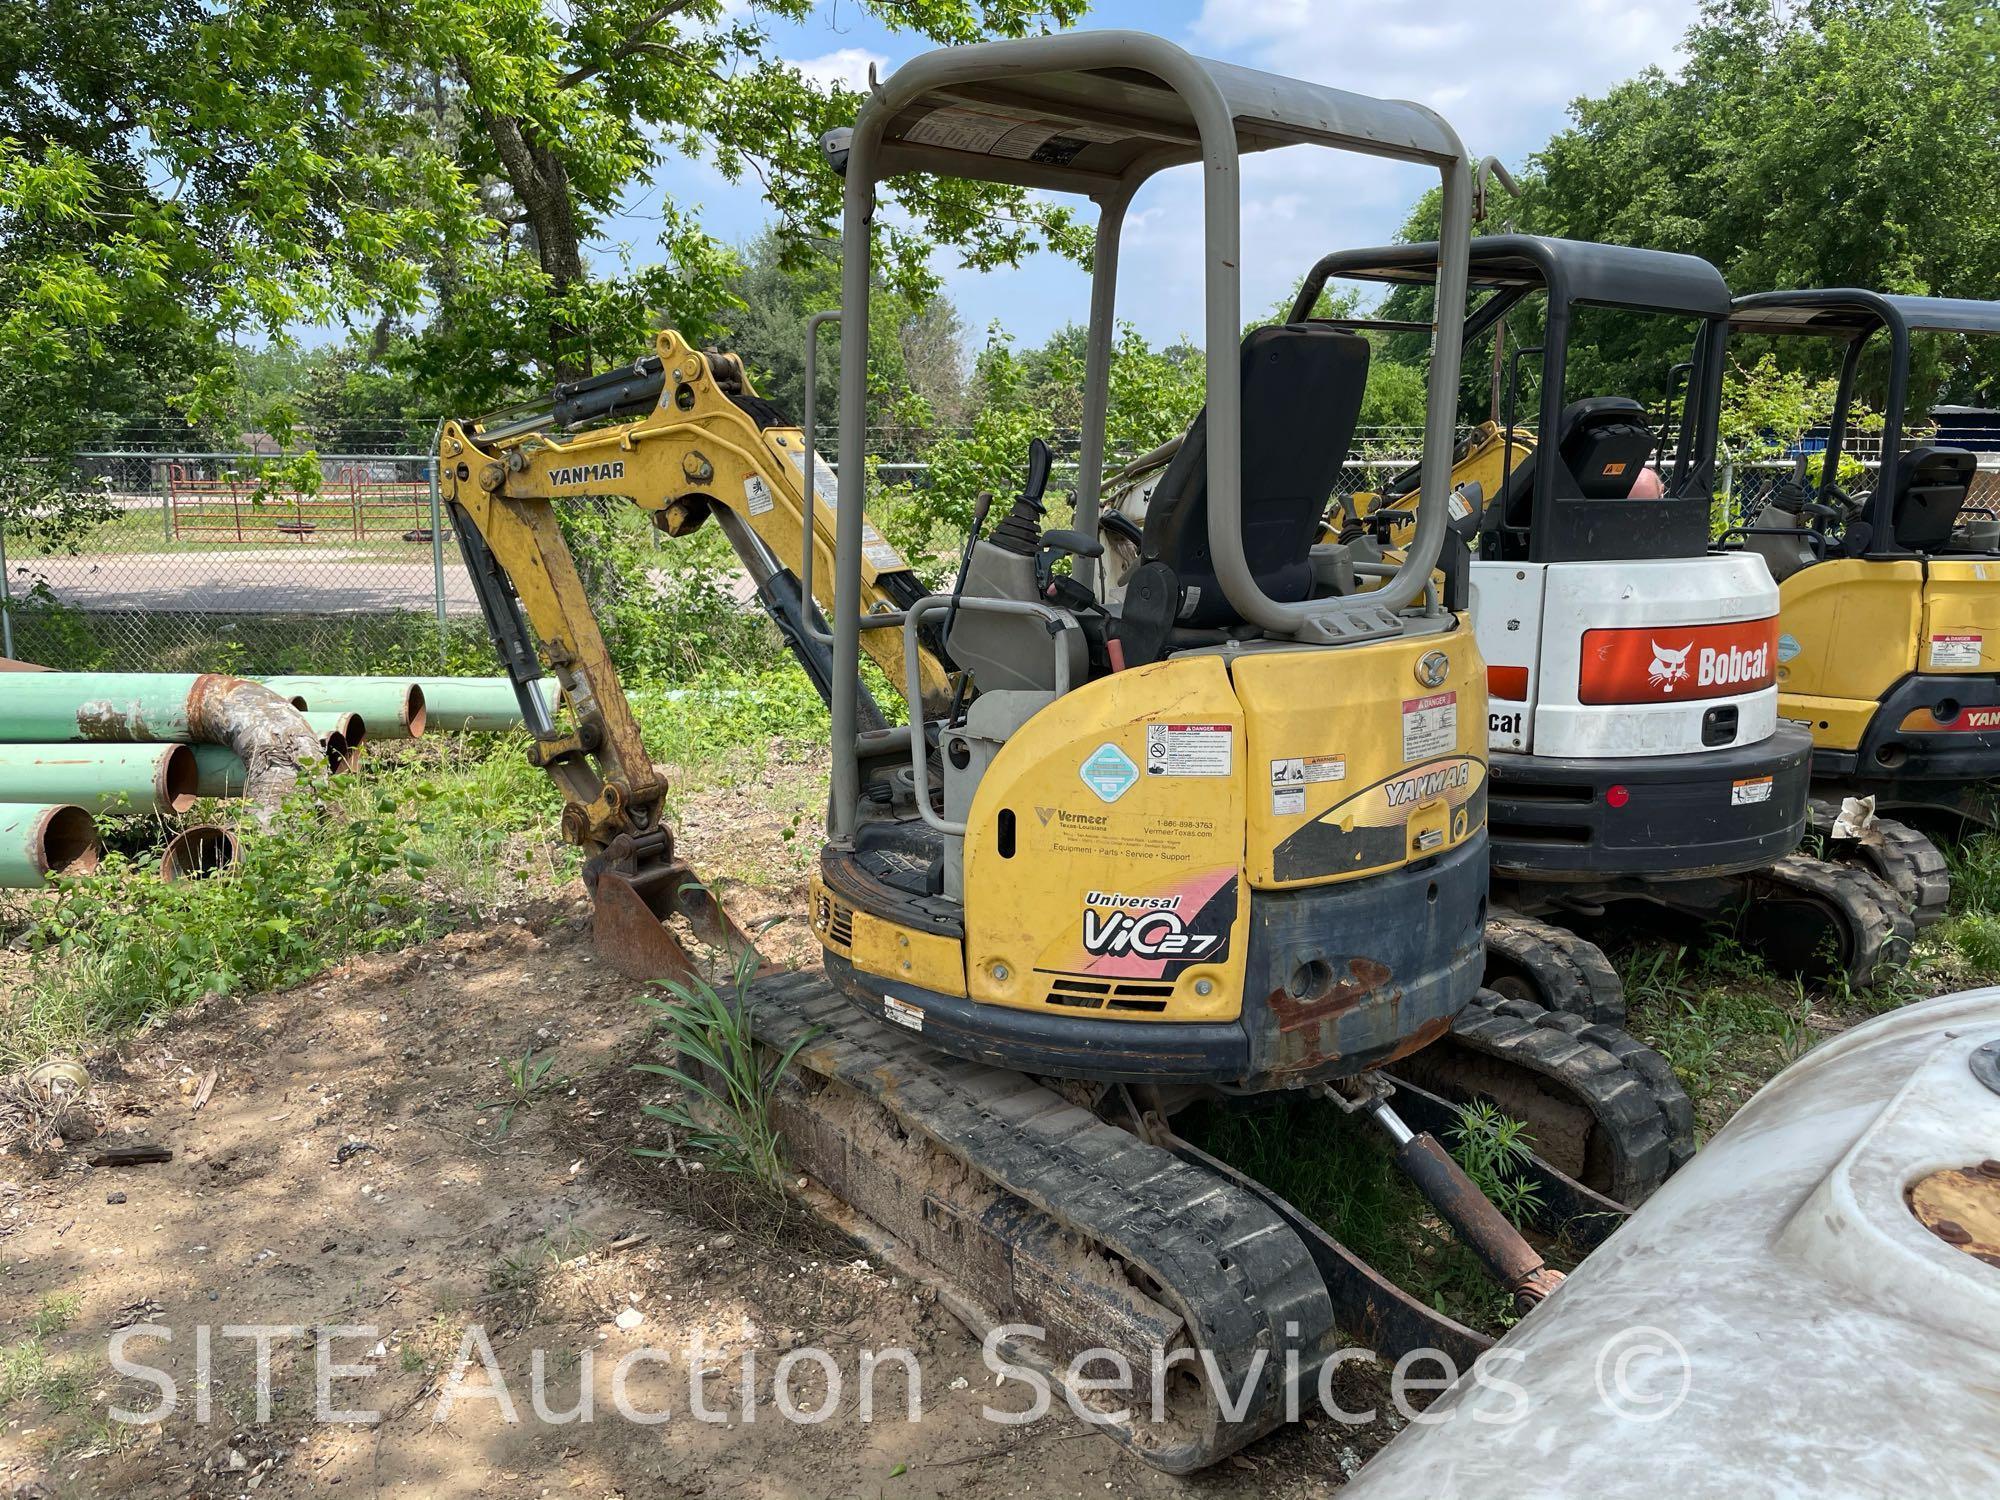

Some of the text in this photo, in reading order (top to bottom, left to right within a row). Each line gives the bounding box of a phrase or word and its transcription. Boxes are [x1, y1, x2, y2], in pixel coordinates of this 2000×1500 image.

[548, 461, 625, 487] YANMAR
[1697, 641, 1768, 687] Bobcat
[1423, 696, 1447, 708] DANGER
[1488, 713, 1522, 734] cat
[1967, 712, 2000, 727] YAN
[1385, 761, 1470, 808] YANMAR
[1057, 810, 1108, 826] Vermeer
[1143, 827, 1213, 838] VermeerTexas.com
[1053, 843, 1092, 855] Equipment
[1099, 848, 1119, 857] Parts
[1125, 849, 1154, 859] Service
[1160, 852, 1191, 862] Support
[1086, 892, 1181, 909] Universal
